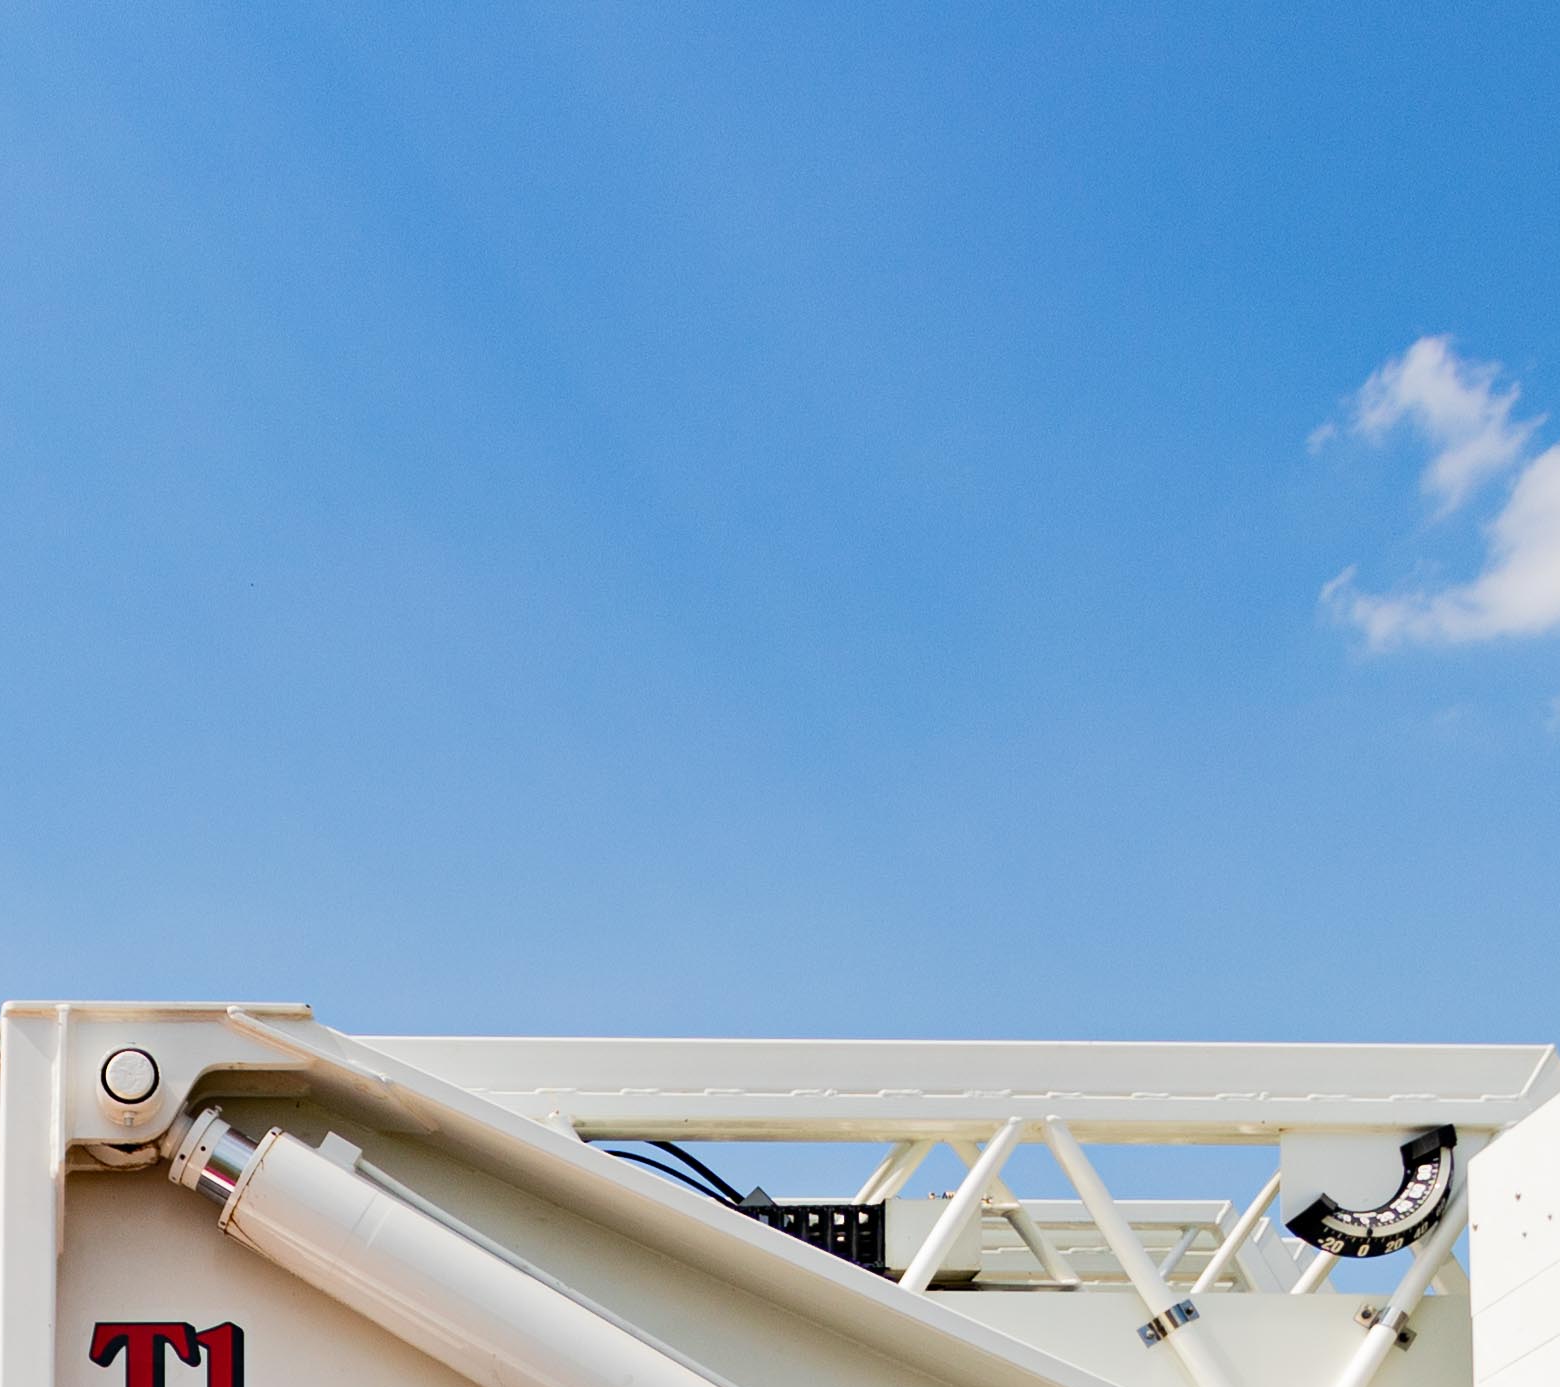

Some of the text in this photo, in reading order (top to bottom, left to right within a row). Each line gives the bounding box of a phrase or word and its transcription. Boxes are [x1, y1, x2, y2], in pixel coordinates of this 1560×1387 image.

[1317, 1236, 1345, 1254] -20
[1357, 1244, 1370, 1257] 0
[1385, 1238, 1405, 1253] 20
